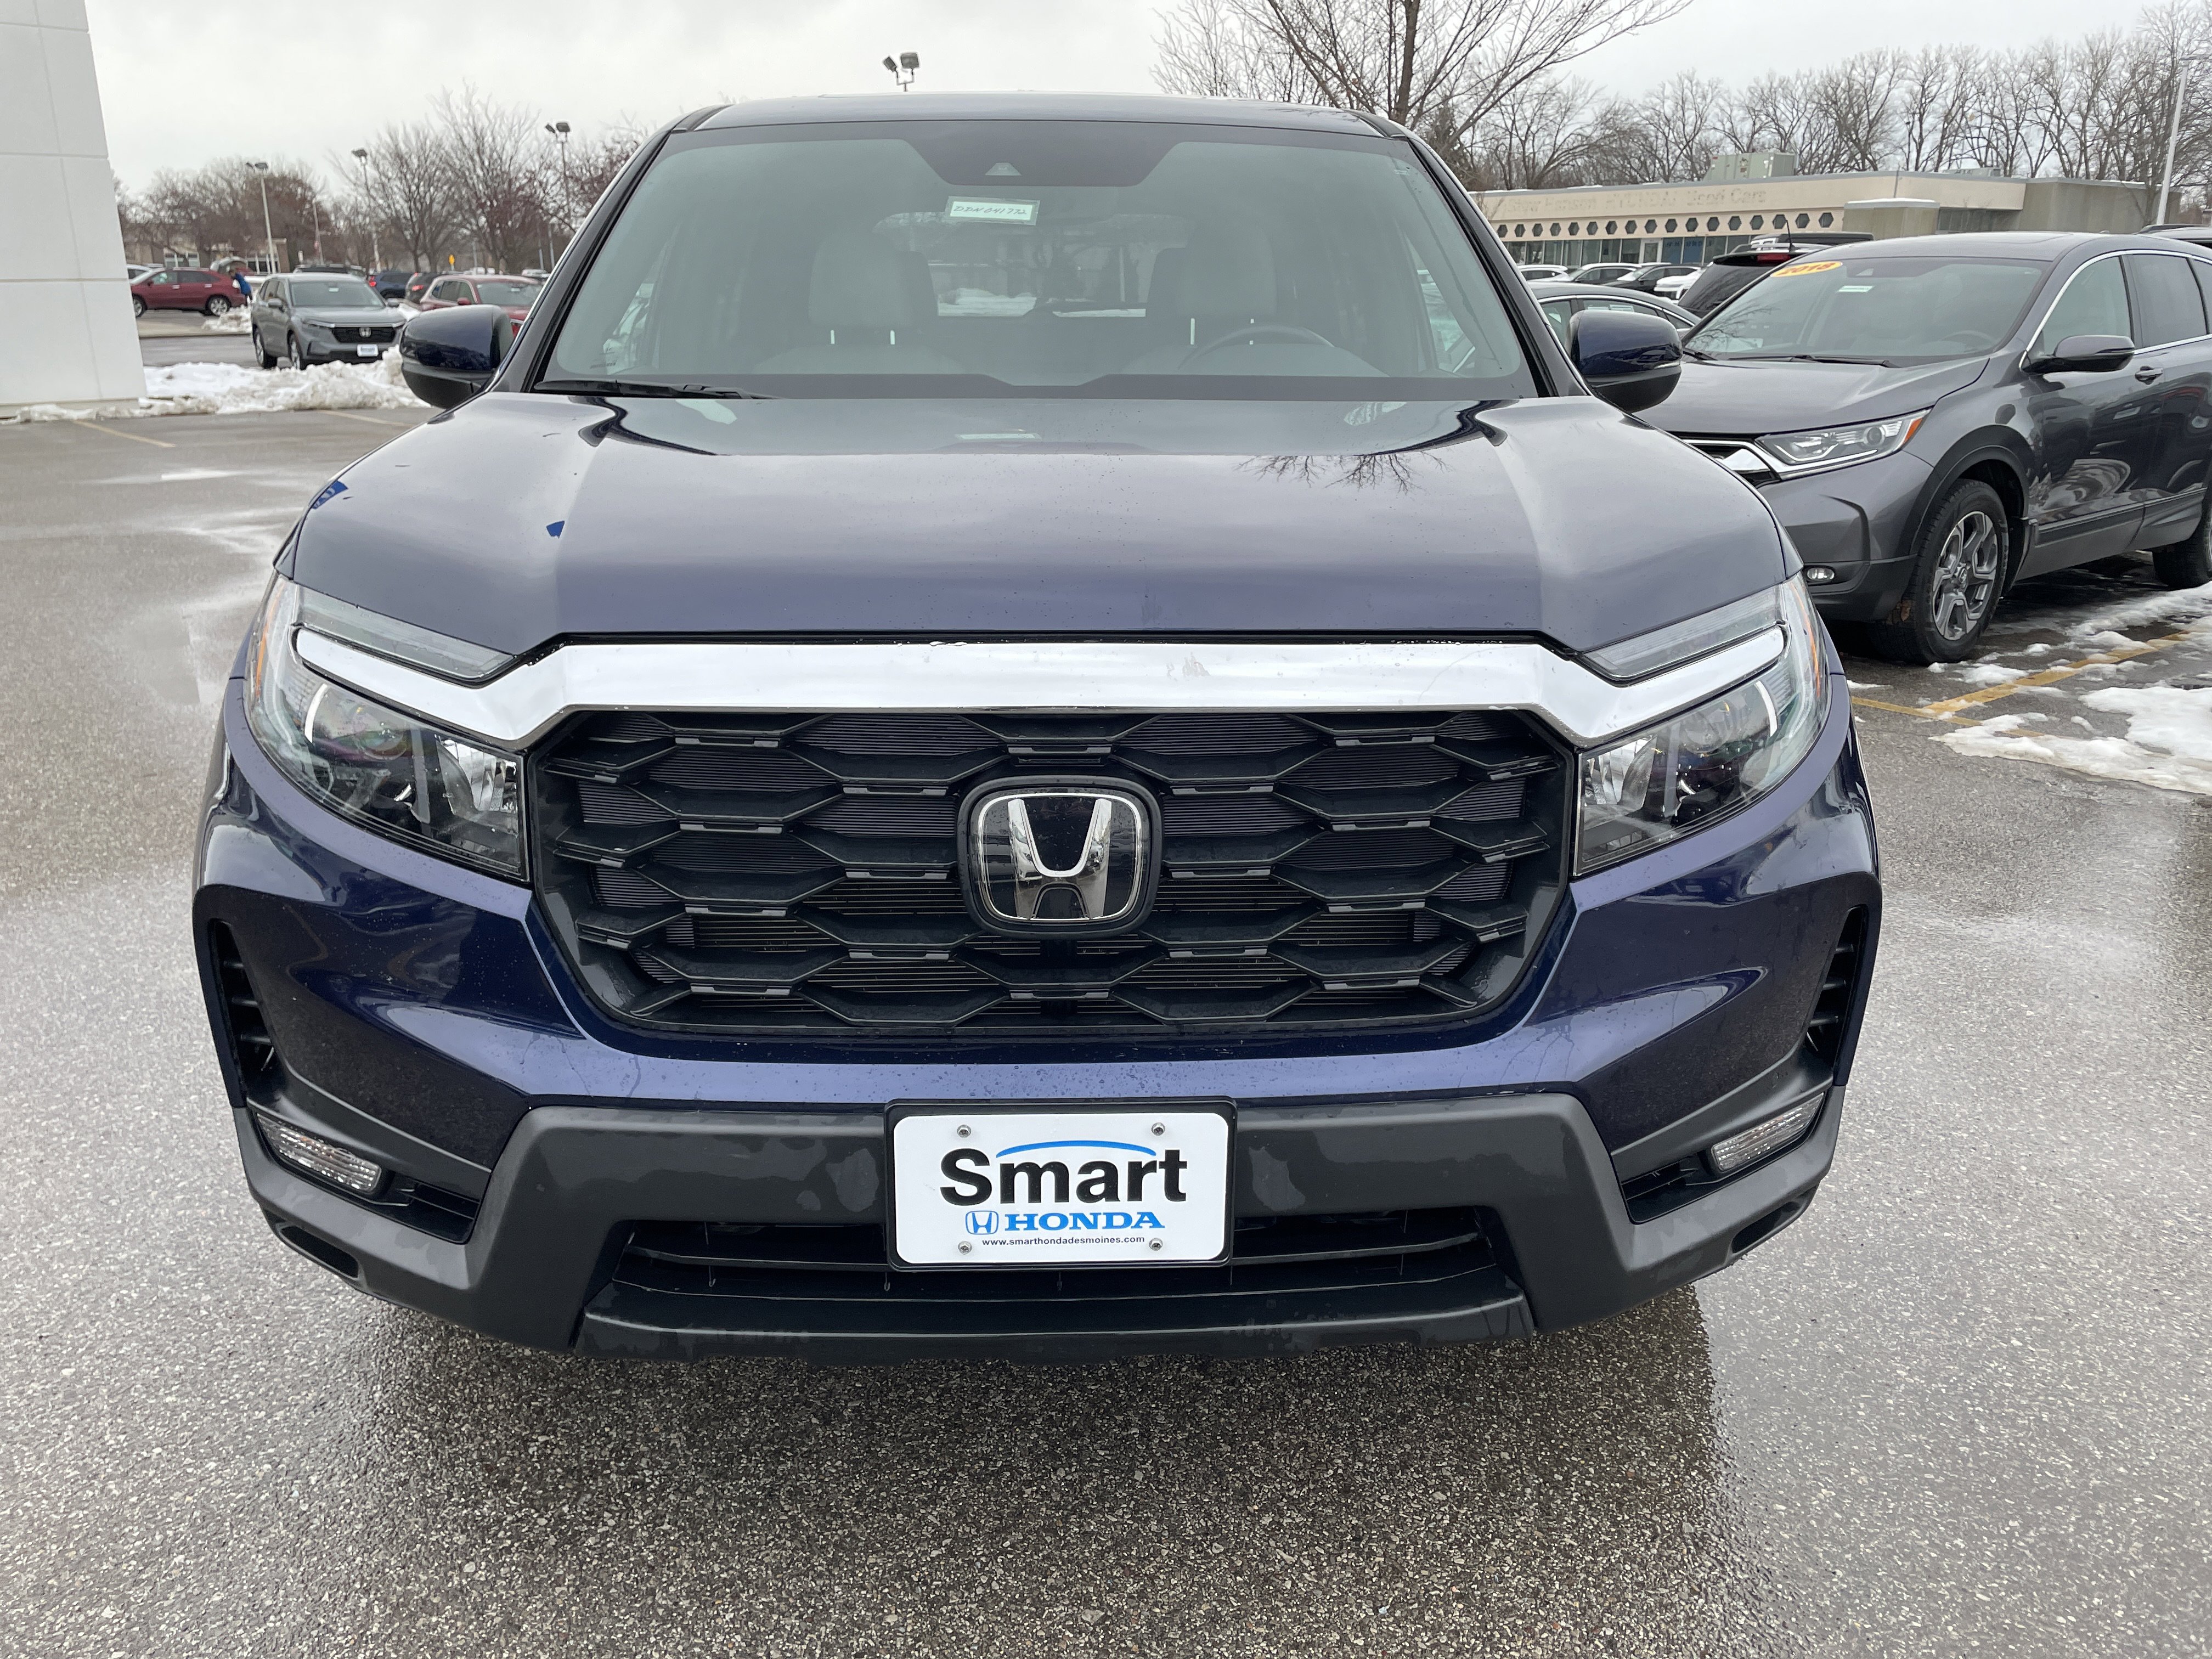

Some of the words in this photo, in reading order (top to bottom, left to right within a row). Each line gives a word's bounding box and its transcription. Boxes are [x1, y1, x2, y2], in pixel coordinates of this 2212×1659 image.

[940, 1148, 1187, 1206] Smart
[1005, 1211, 1166, 1231] HONDA
[981, 1235, 1145, 1245] www.smarthondadesmoines.com
